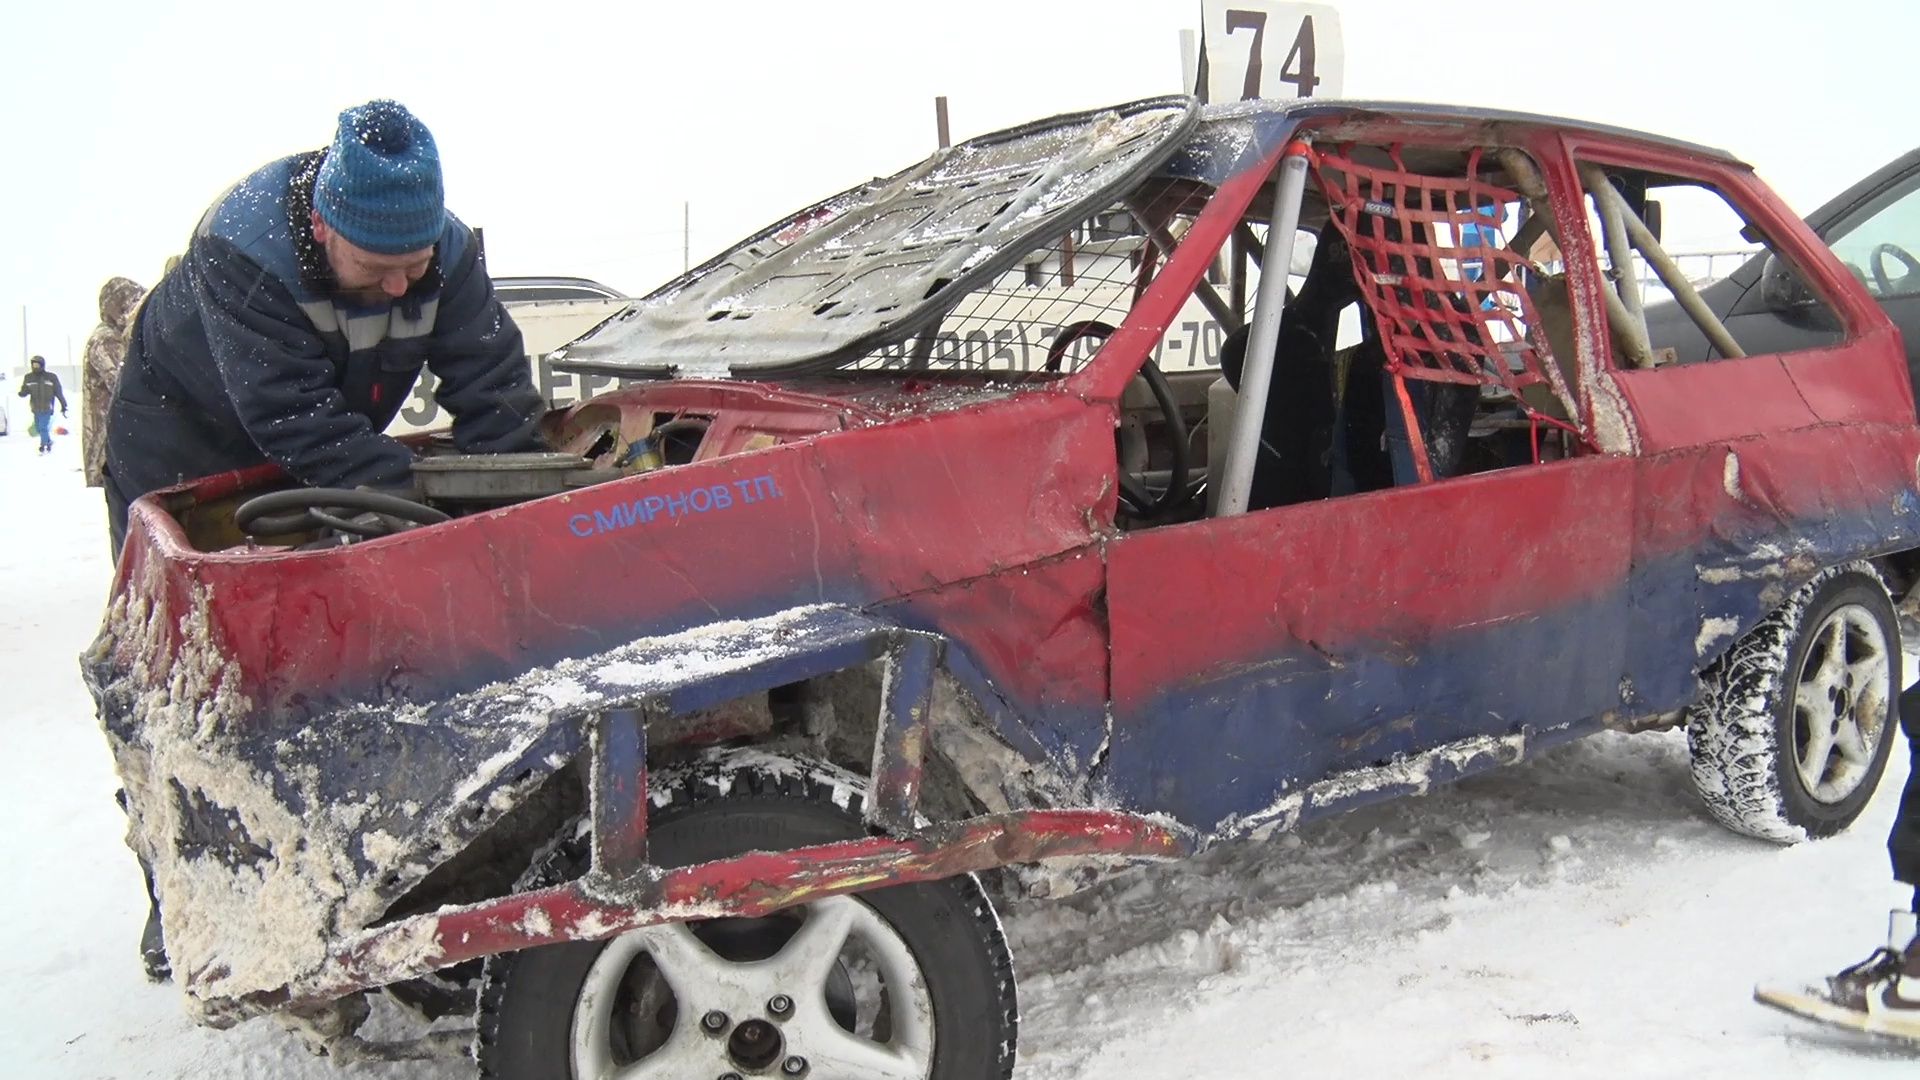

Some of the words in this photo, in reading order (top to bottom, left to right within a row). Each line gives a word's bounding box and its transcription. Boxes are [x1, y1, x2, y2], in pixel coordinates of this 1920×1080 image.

[1225, 9, 1320, 100] 74
[935, 322, 1030, 371] 905)
[568, 485, 733, 537] СМИРНОВ
